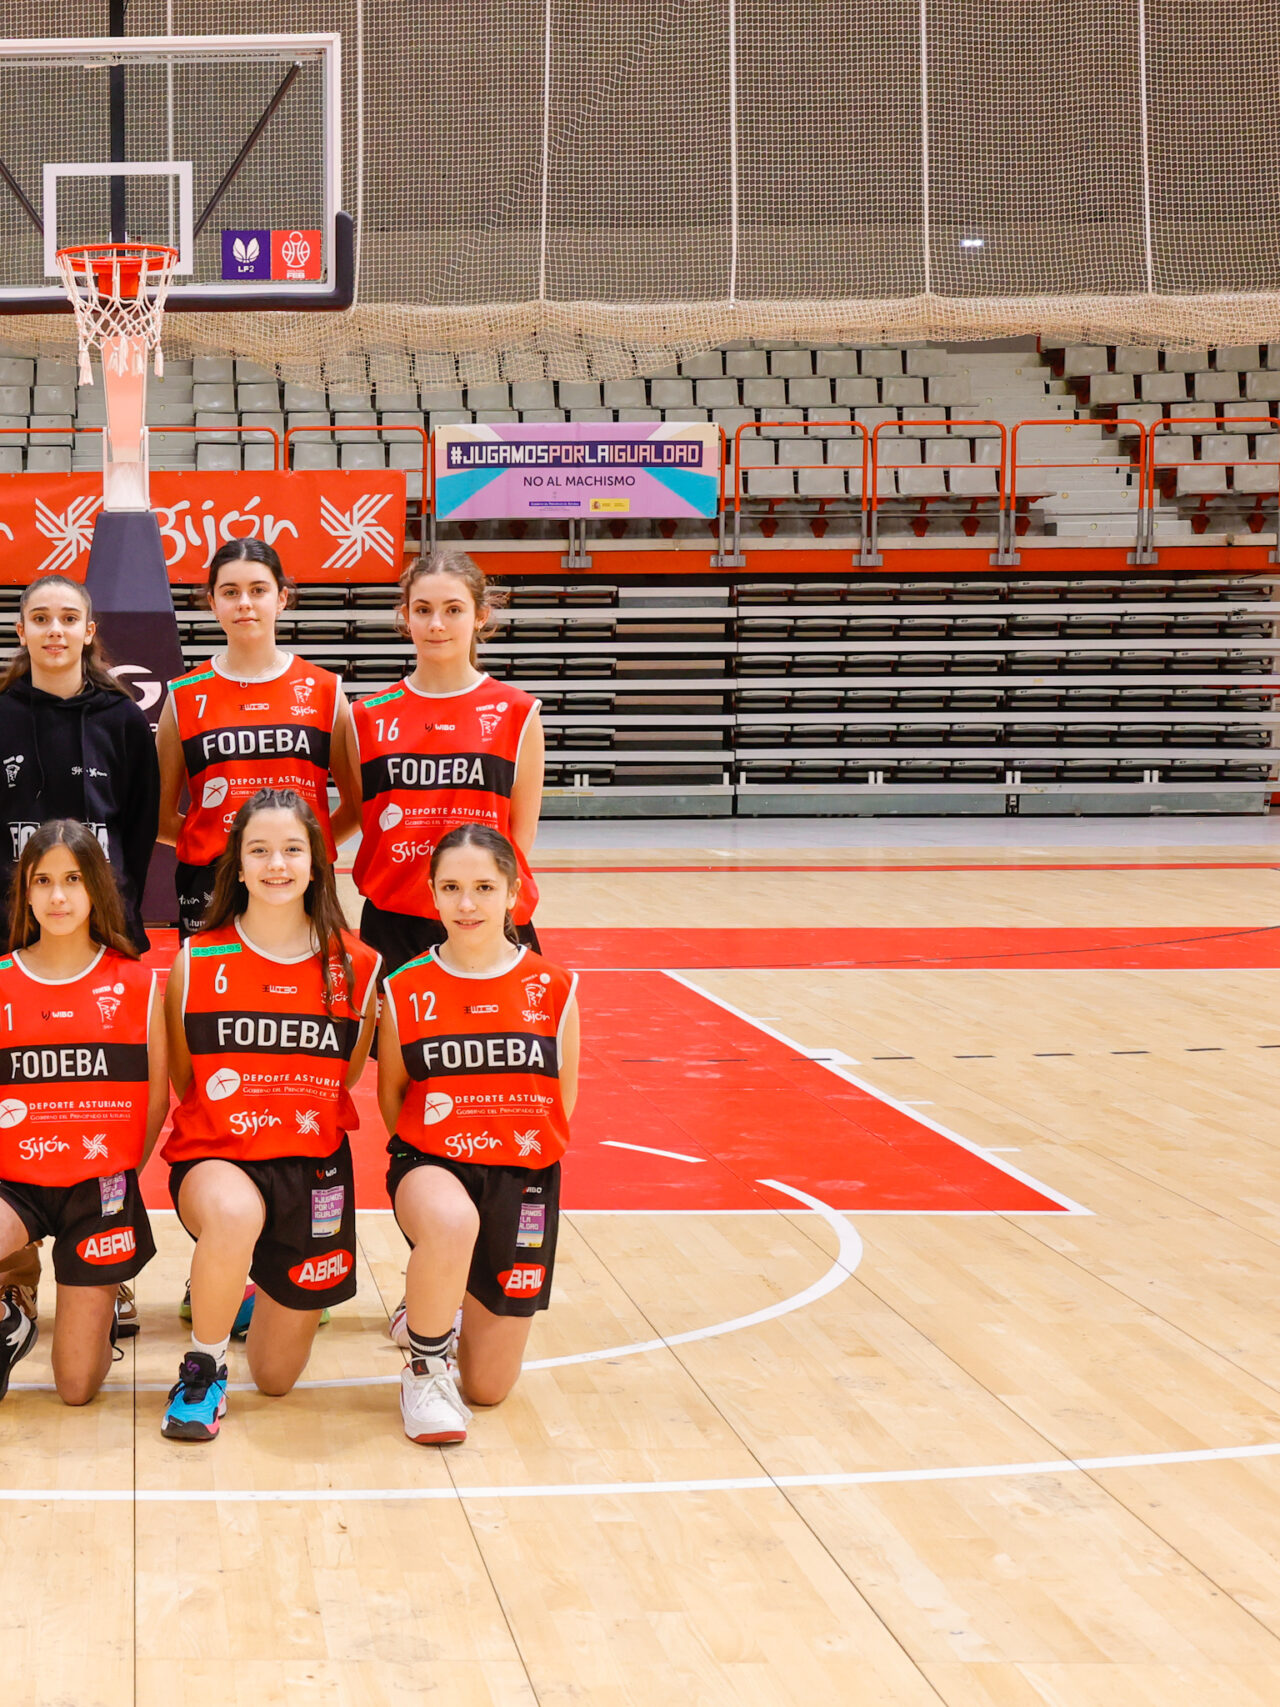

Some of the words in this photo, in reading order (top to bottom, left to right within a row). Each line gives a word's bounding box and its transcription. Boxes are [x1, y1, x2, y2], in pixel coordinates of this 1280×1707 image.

[238, 265, 254, 273] LF2
[450, 443, 700, 465] #JUGAMOSPORLAIGUALDAD
[523, 476, 543, 487] NO
[546, 476, 562, 487] AL
[566, 475, 636, 487] MACHISMO
[195, 694, 207, 719] 7
[375, 718, 400, 742] 16
[202, 728, 311, 760] FODEBA
[229, 776, 274, 786] DEPORTE
[387, 757, 485, 786] FODEBA
[404, 807, 448, 817] DEPORTE
[214, 963, 228, 994] 6
[409, 990, 438, 1023] 12
[217, 1017, 340, 1051] FODEBA
[10, 1048, 109, 1079] FODEBA
[422, 1038, 545, 1070] FODEBA
[242, 1073, 290, 1083] DEPORTE
[29, 1101, 74, 1110] DEPORTE
[454, 1094, 504, 1104] DEPORTE
[228, 1108, 282, 1136] gijón
[18, 1135, 70, 1161] gijón
[444, 1130, 503, 1158] gijón
[83, 1230, 137, 1259] ABRIL
[297, 1252, 349, 1283] ABRIL
[505, 1268, 543, 1290] BRIL
